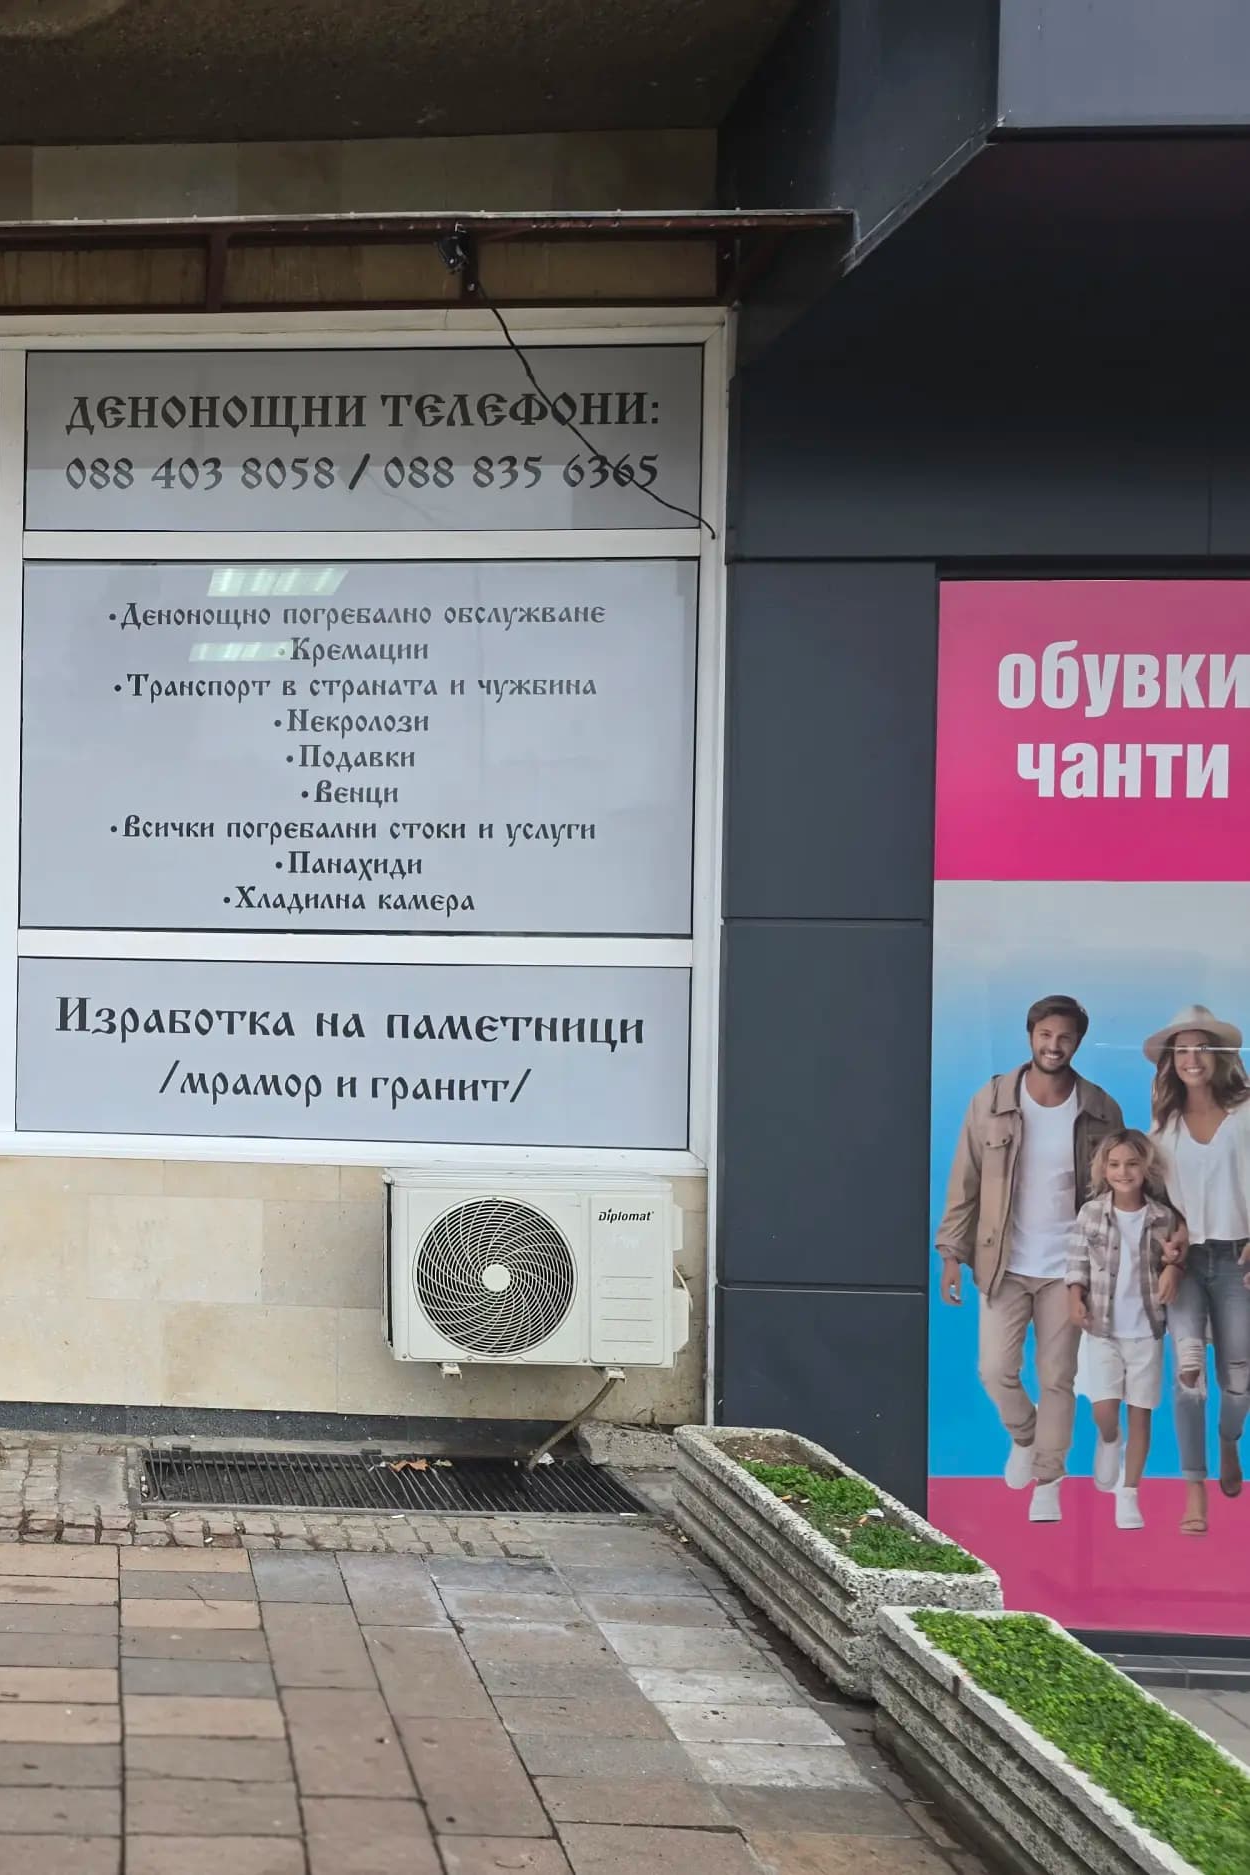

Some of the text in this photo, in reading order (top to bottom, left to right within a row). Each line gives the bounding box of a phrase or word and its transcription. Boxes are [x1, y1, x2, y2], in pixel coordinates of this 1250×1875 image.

[65, 392, 660, 436] ДЕНОНОЩНИ ТЕЛЕФОНИ:
[65, 453, 658, 490] 088 403 8058 / 088 835 6365
[120, 602, 607, 632] Денонощно погребално обслужване
[289, 636, 429, 668] Кремации
[126, 673, 597, 704] Транспорт в страната и чужбина
[999, 640, 1250, 717] обувки
[286, 708, 429, 740] Некролози
[298, 744, 415, 773] Подавки
[1018, 743, 1229, 798] чанти
[313, 779, 398, 809] Венци
[122, 814, 596, 848] Всички погребални стоки и услуги
[288, 850, 422, 882] Панахиди
[234, 885, 475, 918] Хладилна камера
[55, 997, 644, 1052] Изработка на паметници
[159, 1060, 532, 1110] /мрамор и гранит/
[598, 1208, 651, 1223] Diplomat
